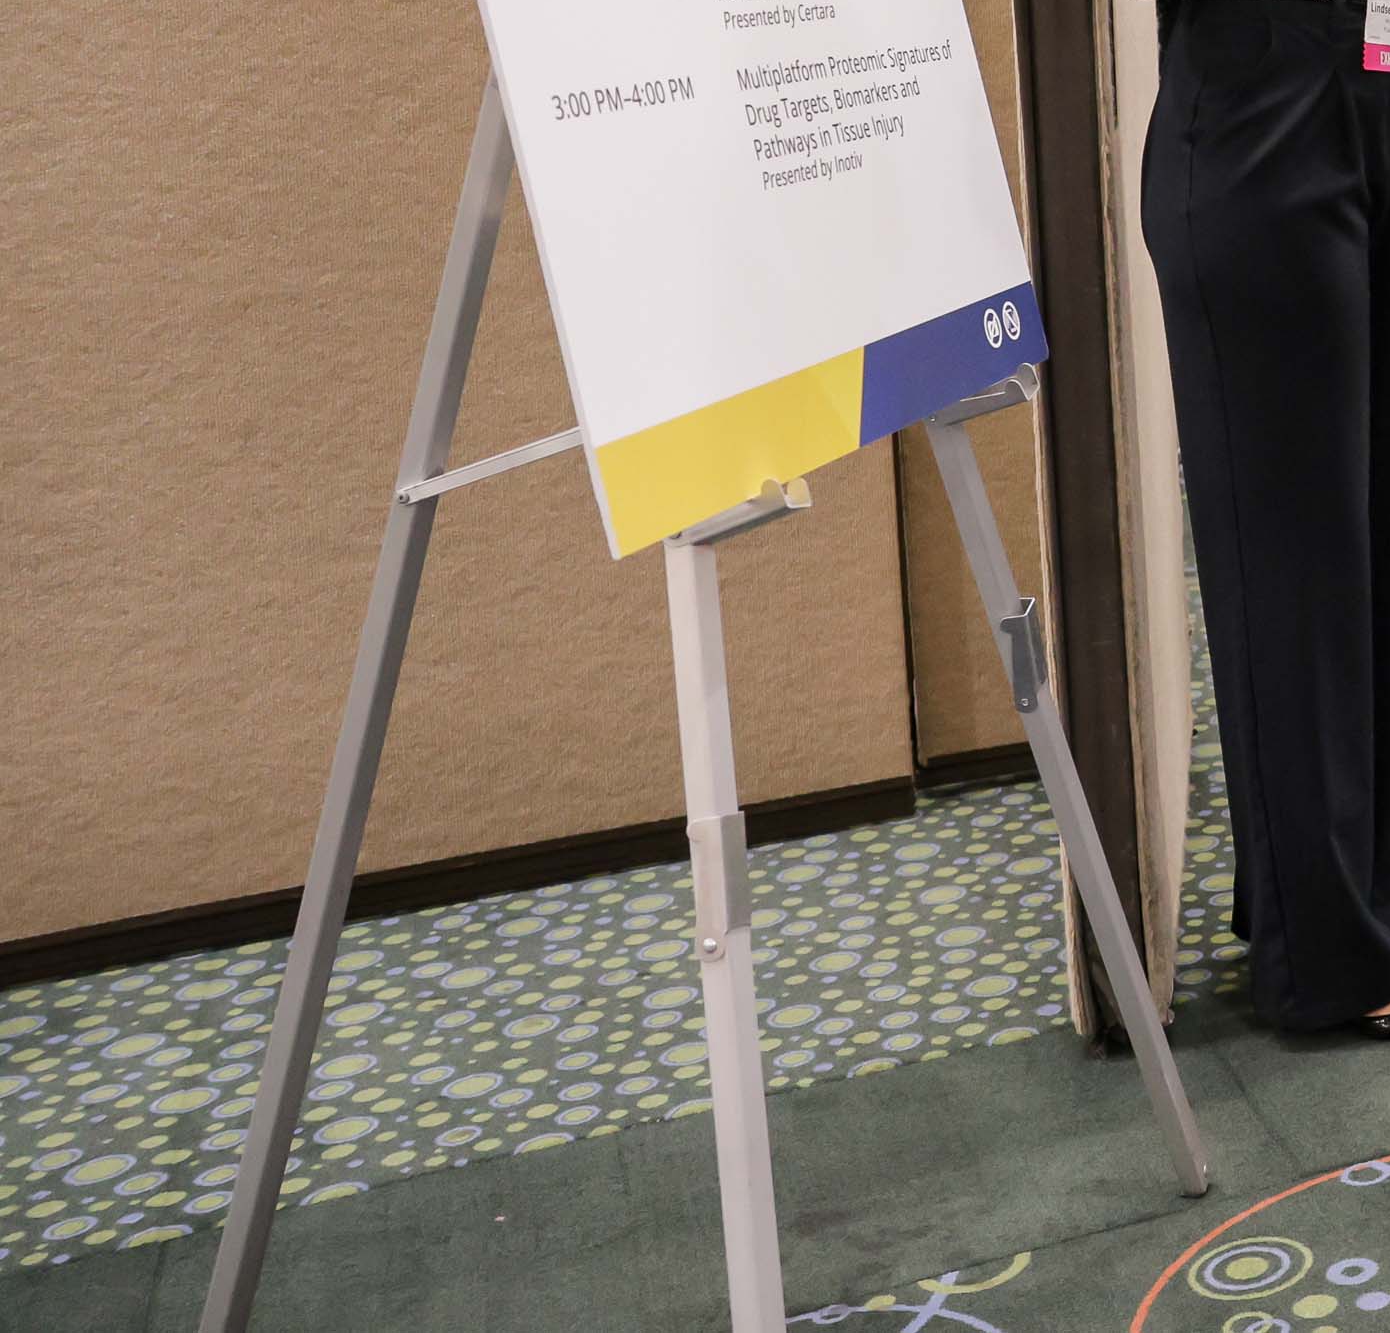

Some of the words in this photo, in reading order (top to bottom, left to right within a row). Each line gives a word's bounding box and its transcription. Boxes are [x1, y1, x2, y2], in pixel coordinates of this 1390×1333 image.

[723, 5, 781, 30] Presented
[782, 5, 796, 29] by
[797, 4, 836, 22] Certara
[736, 59, 828, 92] Multiplatform
[827, 50, 888, 78] Proteomic
[886, 46, 942, 73] Signatures
[941, 39, 953, 60] of
[551, 91, 592, 121] 3:00
[667, 76, 695, 103] PM
[744, 104, 783, 128] Drug
[779, 94, 834, 122] Targets,
[833, 82, 899, 110] Biomarkers
[899, 75, 921, 99] and
[753, 132, 819, 162] Pathways
[817, 126, 833, 148] in
[831, 122, 872, 144] Tissue
[871, 114, 905, 142] Injury
[762, 160, 819, 191] Presented
[819, 158, 833, 181] by
[834, 151, 863, 173] Inotiv
